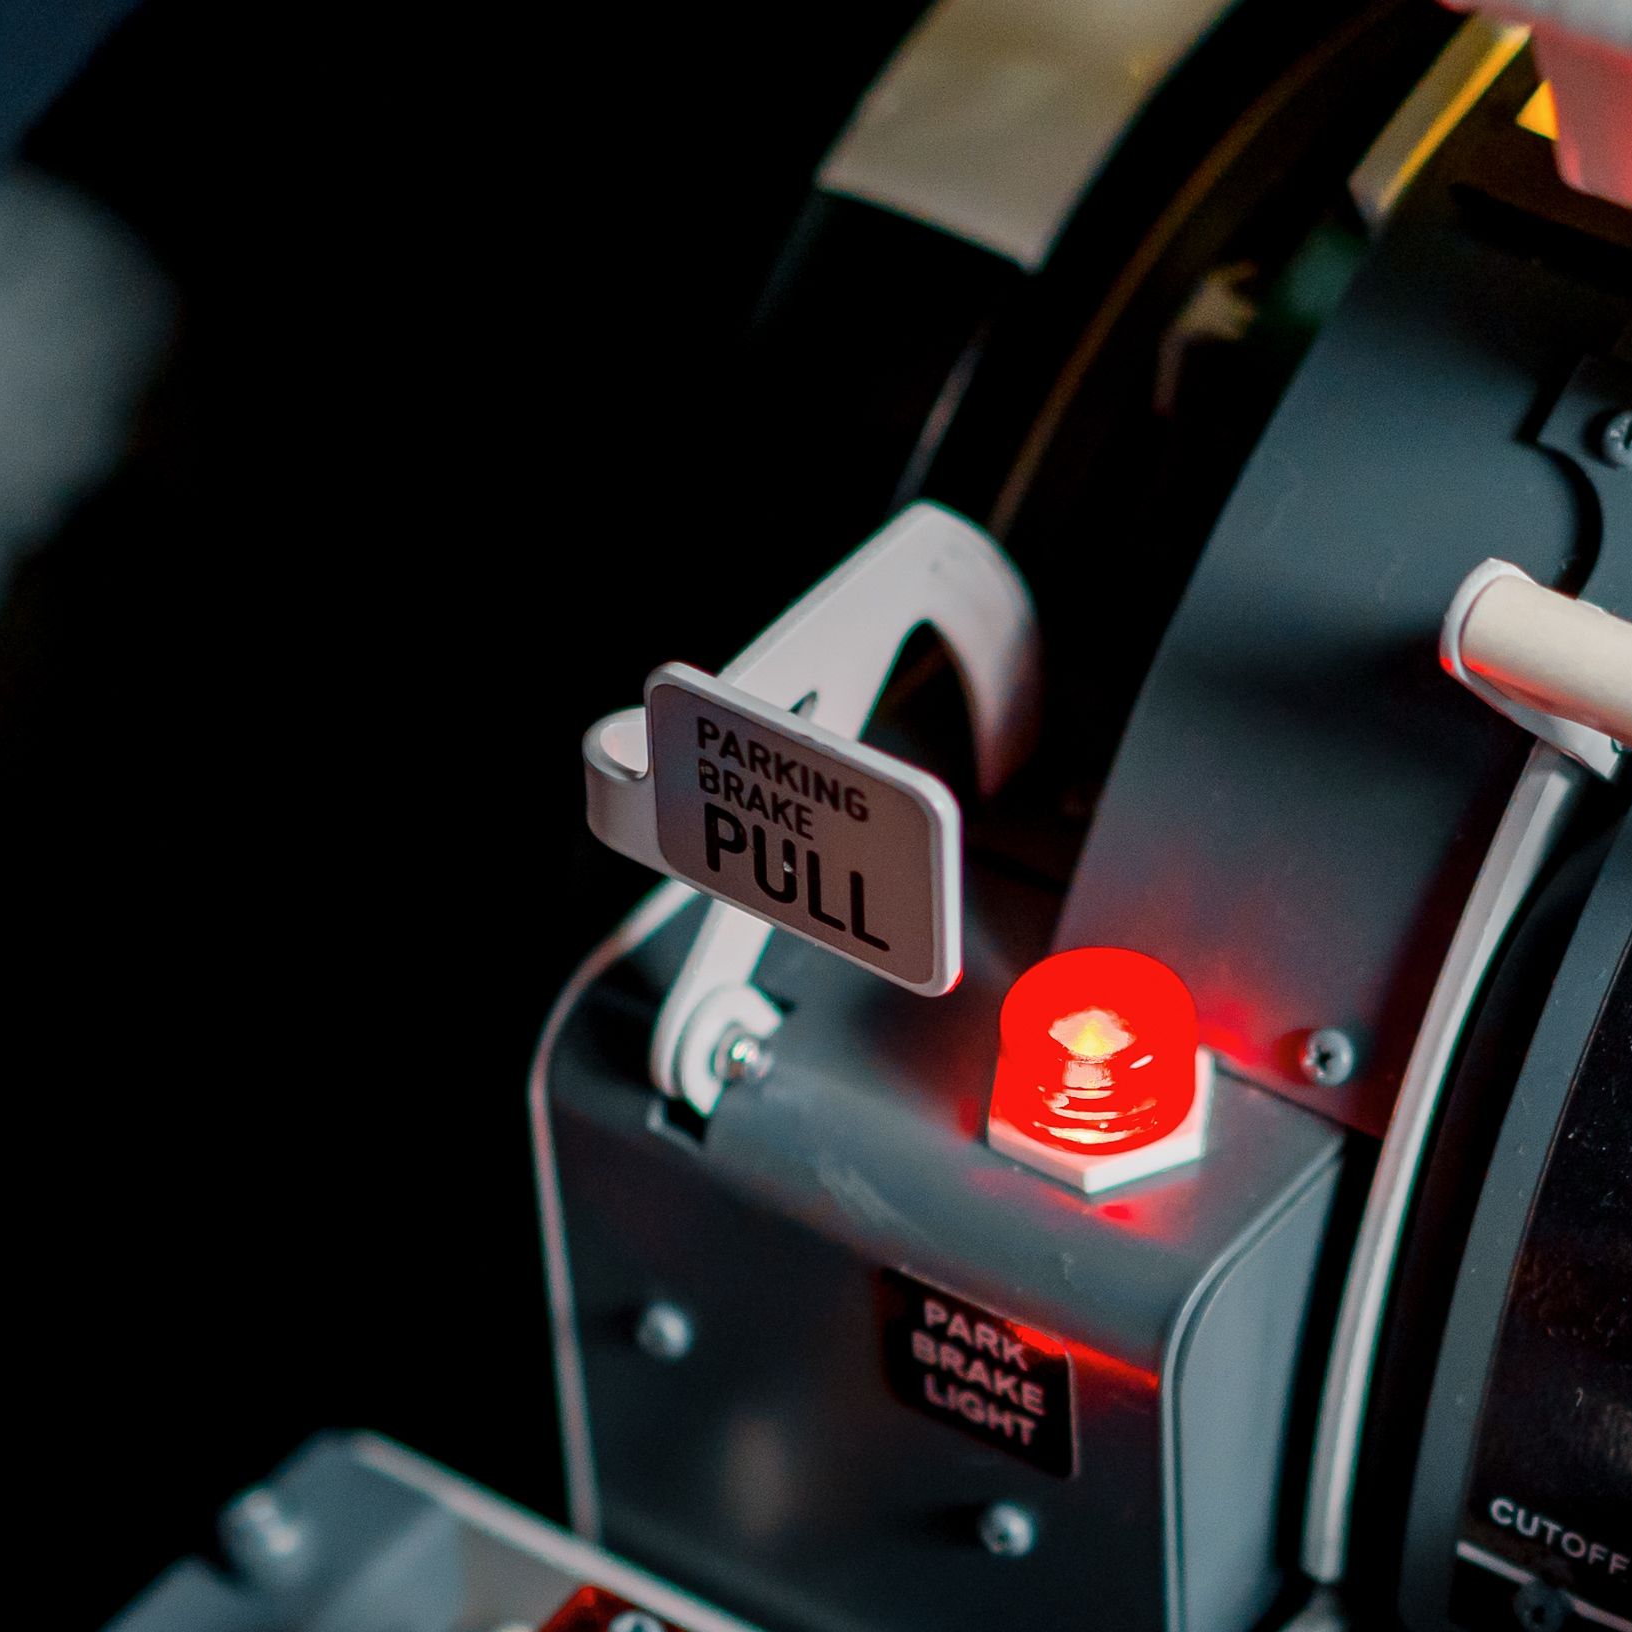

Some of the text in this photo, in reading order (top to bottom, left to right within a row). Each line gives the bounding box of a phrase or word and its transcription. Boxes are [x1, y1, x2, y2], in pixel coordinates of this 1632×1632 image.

[697, 717, 869, 822] PARKING
[698, 758, 814, 840] BRAKE
[704, 802, 890, 953] PULL
[911, 1333, 1044, 1415] BRAKE
[923, 1298, 1029, 1371] PARK
[925, 1375, 1036, 1449] LIGHT
[1489, 1497, 1632, 1577] CUTOFF
